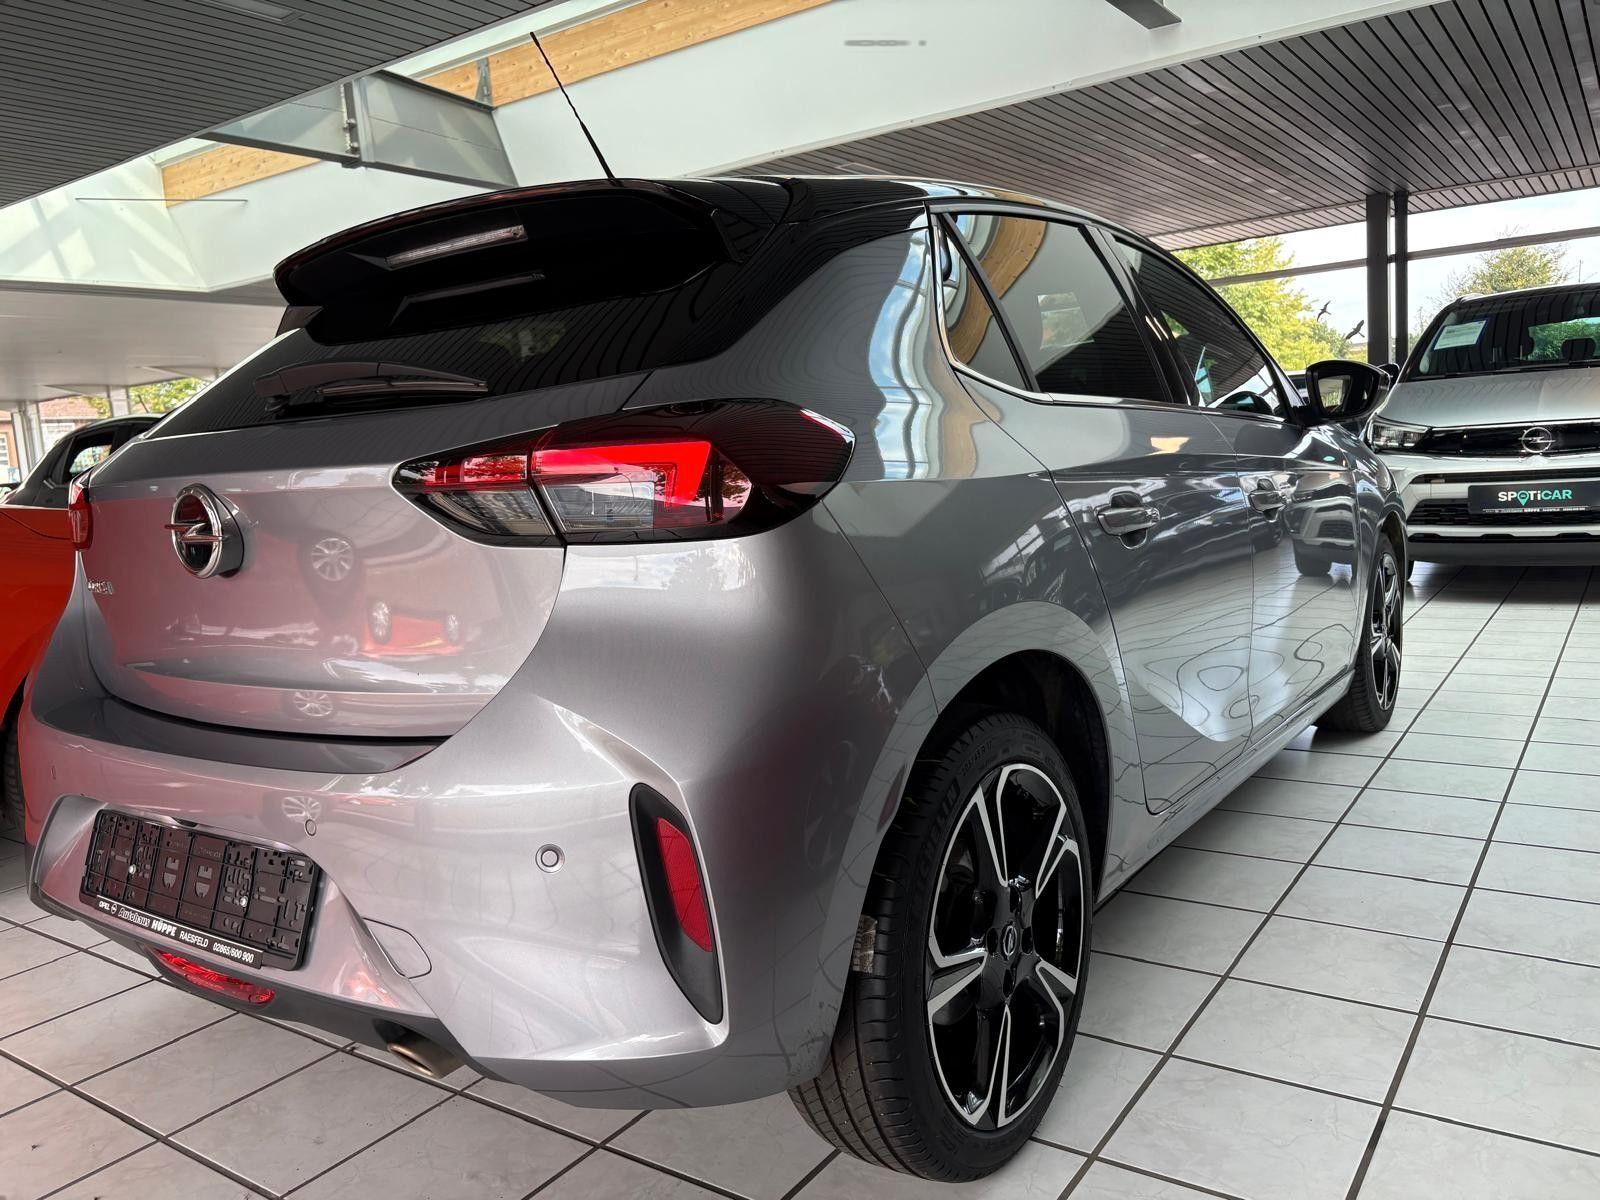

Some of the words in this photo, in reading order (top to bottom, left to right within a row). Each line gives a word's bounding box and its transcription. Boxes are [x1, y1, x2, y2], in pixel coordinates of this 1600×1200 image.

[98, 900, 110, 911] OPEL
[118, 907, 151, 927] Autohaus
[151, 919, 177, 937] HÜPPE
[179, 930, 209, 948] RAESFELD
[242, 951, 255, 963] 900
